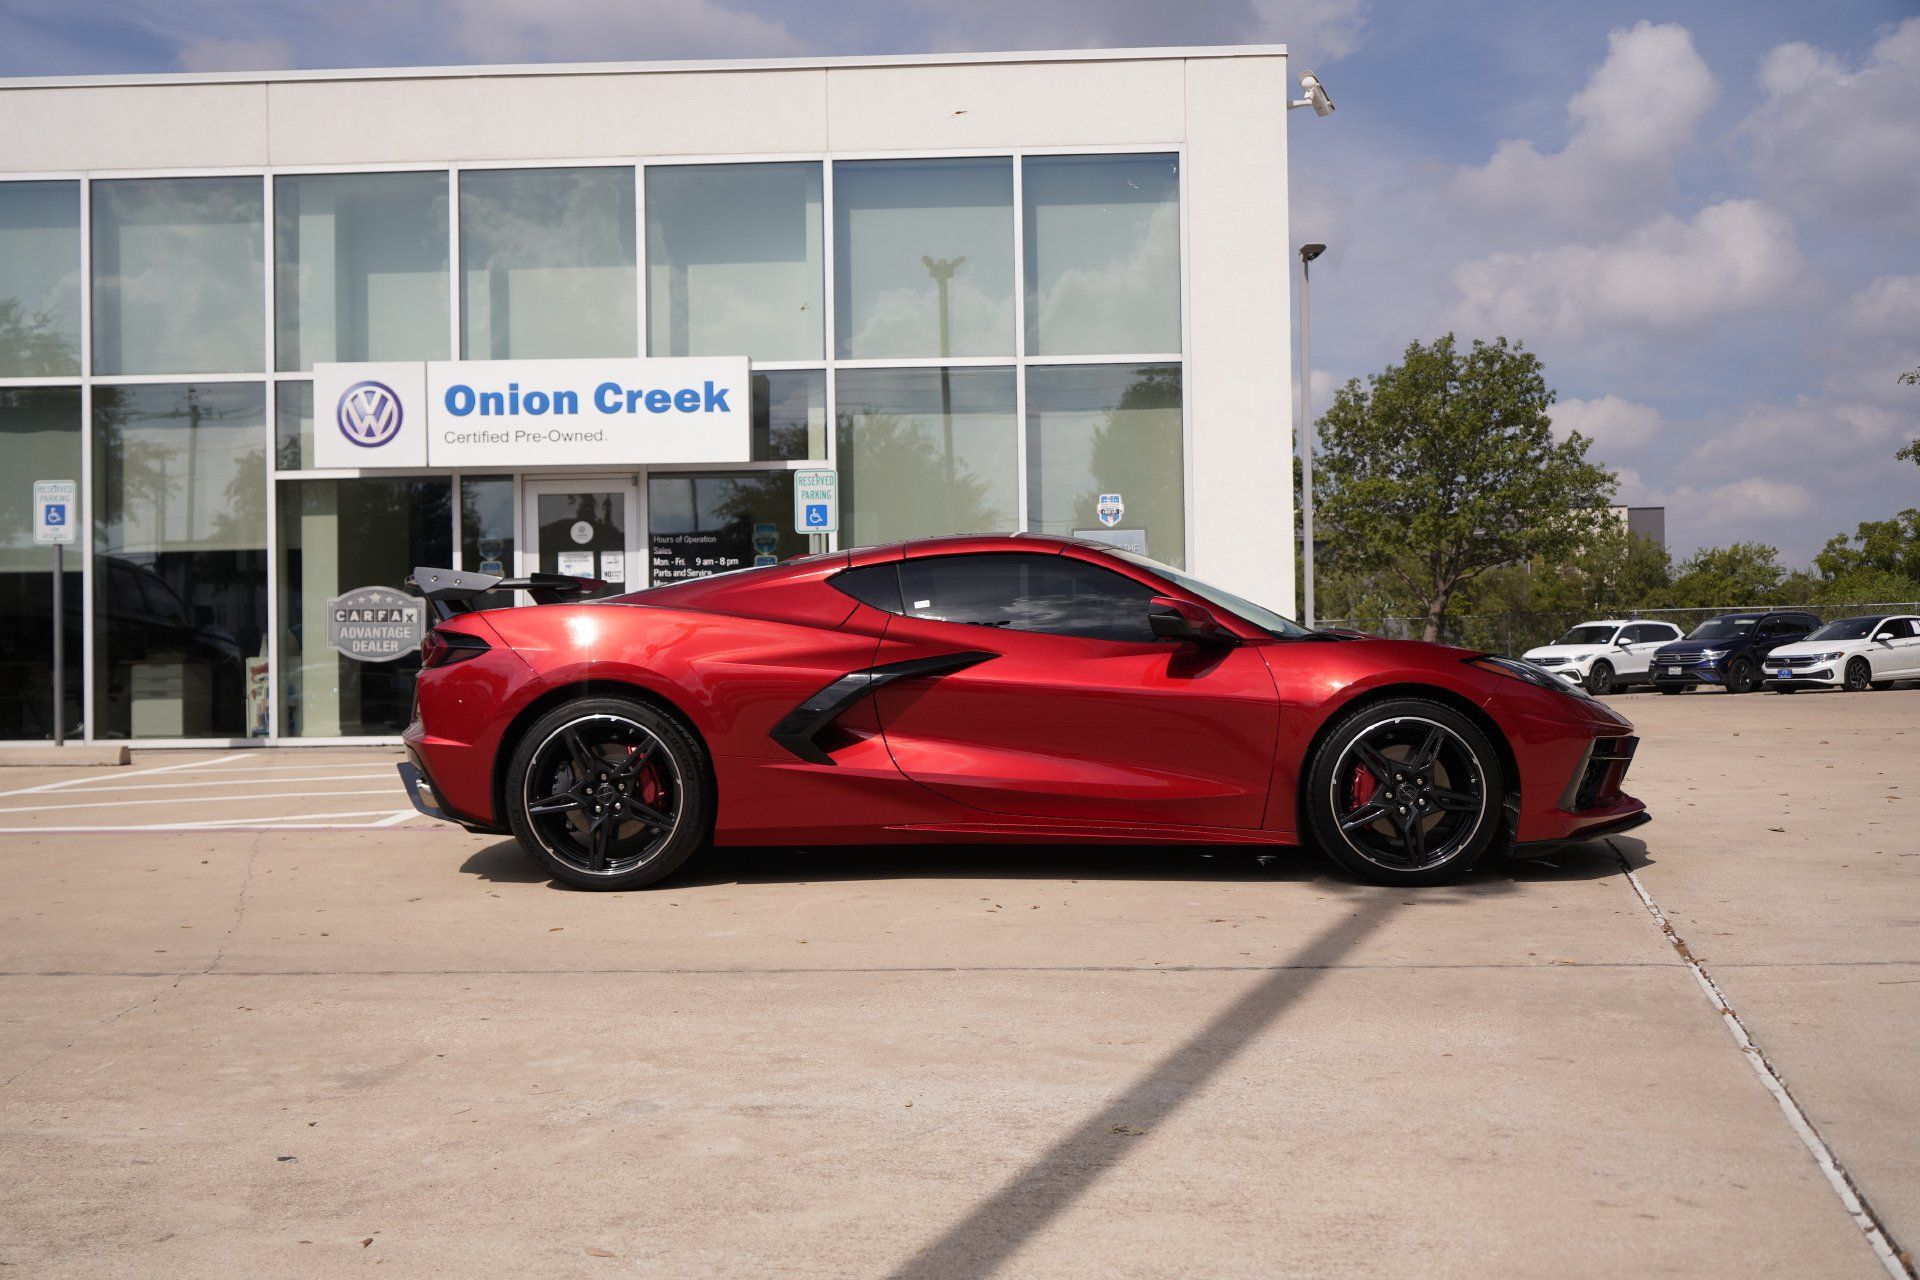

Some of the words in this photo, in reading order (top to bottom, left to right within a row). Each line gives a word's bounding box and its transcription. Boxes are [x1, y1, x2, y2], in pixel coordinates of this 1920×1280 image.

[444, 382, 579, 417] Onion
[594, 380, 731, 415] Creek
[444, 430, 509, 444] Certified
[515, 429, 607, 443] Pre-Owned.
[798, 476, 833, 486] RESERVED
[801, 489, 832, 500] PARKING
[653, 535, 674, 544] Hours
[675, 535, 683, 544] of
[684, 535, 717, 544] Operation
[653, 546, 672, 555] Sales
[695, 557, 702, 566] 9
[719, 556, 726, 566] 8
[726, 558, 739, 567] pm
[653, 568, 672, 577] Parts
[672, 568, 687, 577] and
[335, 608, 417, 623] CARFAX
[340, 626, 411, 639] ADVANTAGE
[352, 640, 399, 652] DEALER
